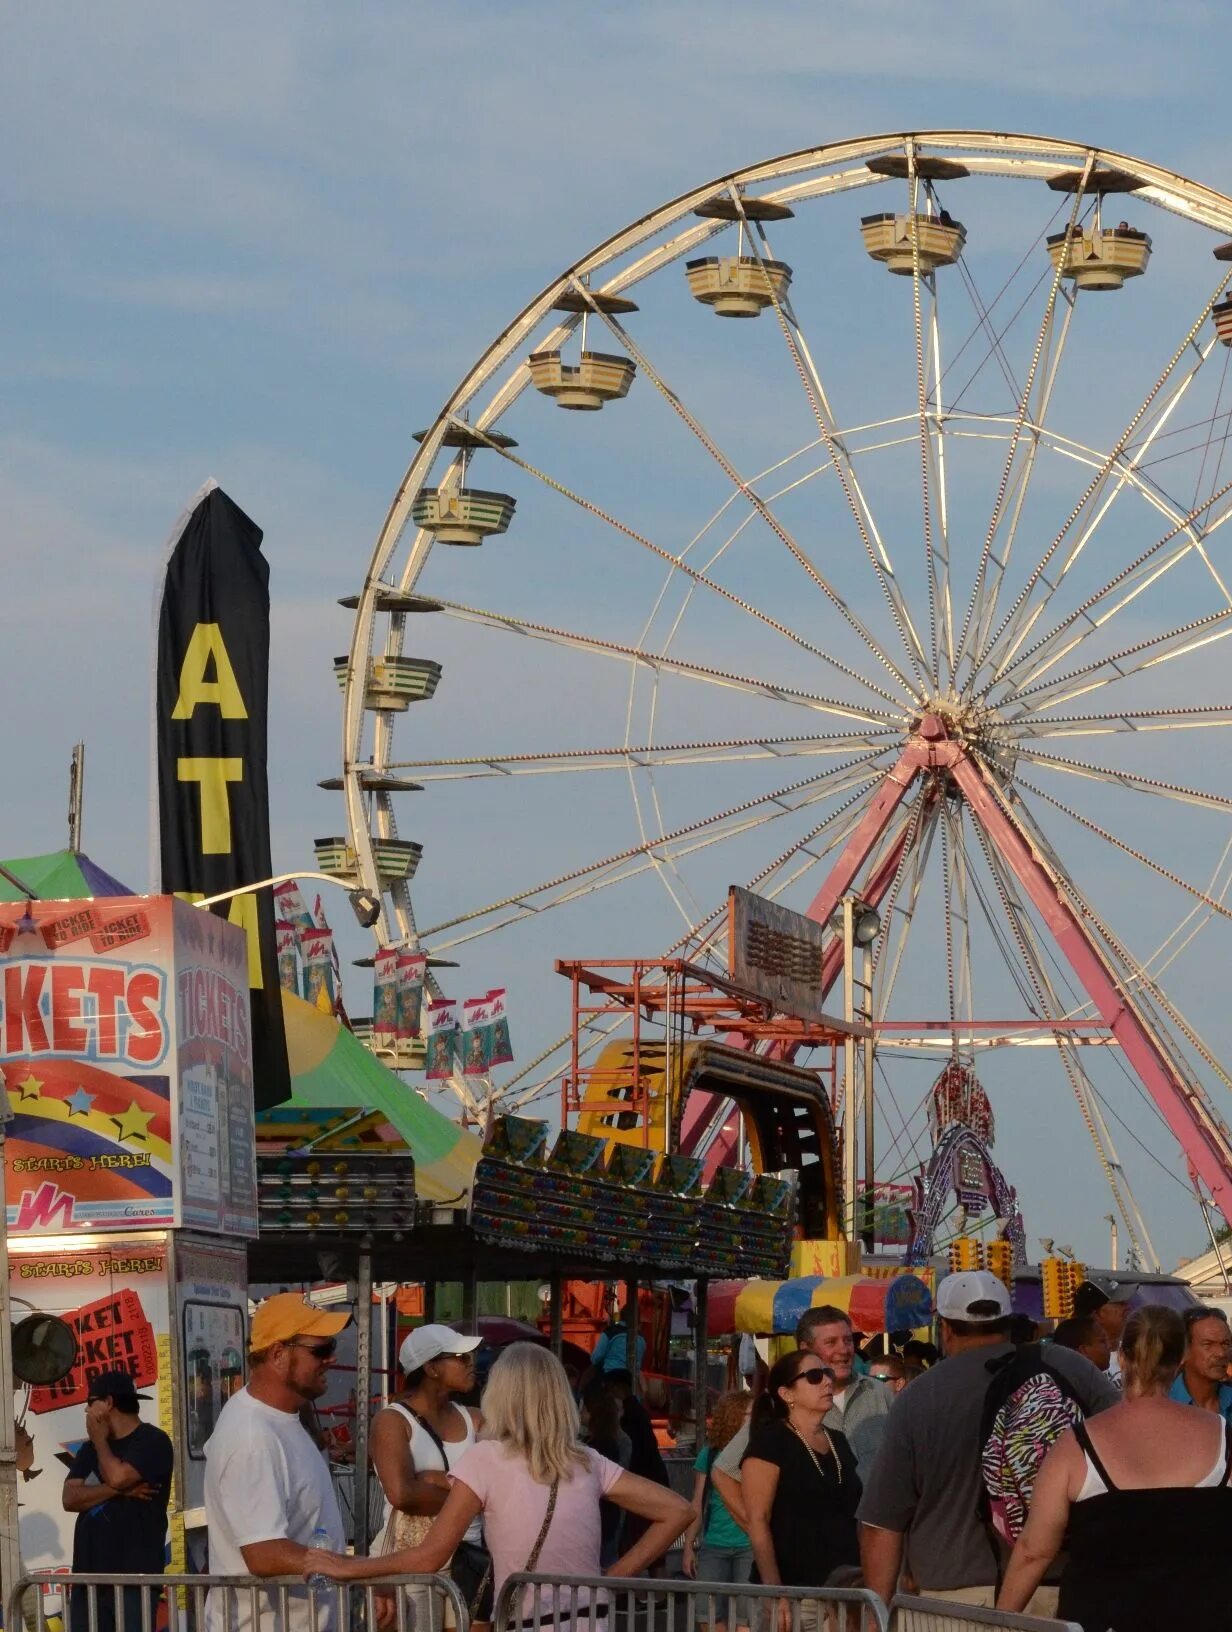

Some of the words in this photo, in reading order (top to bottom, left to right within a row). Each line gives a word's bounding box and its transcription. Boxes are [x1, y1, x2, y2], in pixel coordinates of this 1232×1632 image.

[71, 920, 95, 937] RIDE
[2, 965, 163, 1062] KETS
[178, 967, 248, 1059] TICKETS
[13, 1155, 84, 1172] STARTS
[89, 1152, 152, 1171] HERE!
[124, 1206, 156, 1217] Cares
[20, 1260, 94, 1279] STARTS
[98, 1256, 163, 1276] HERE!
